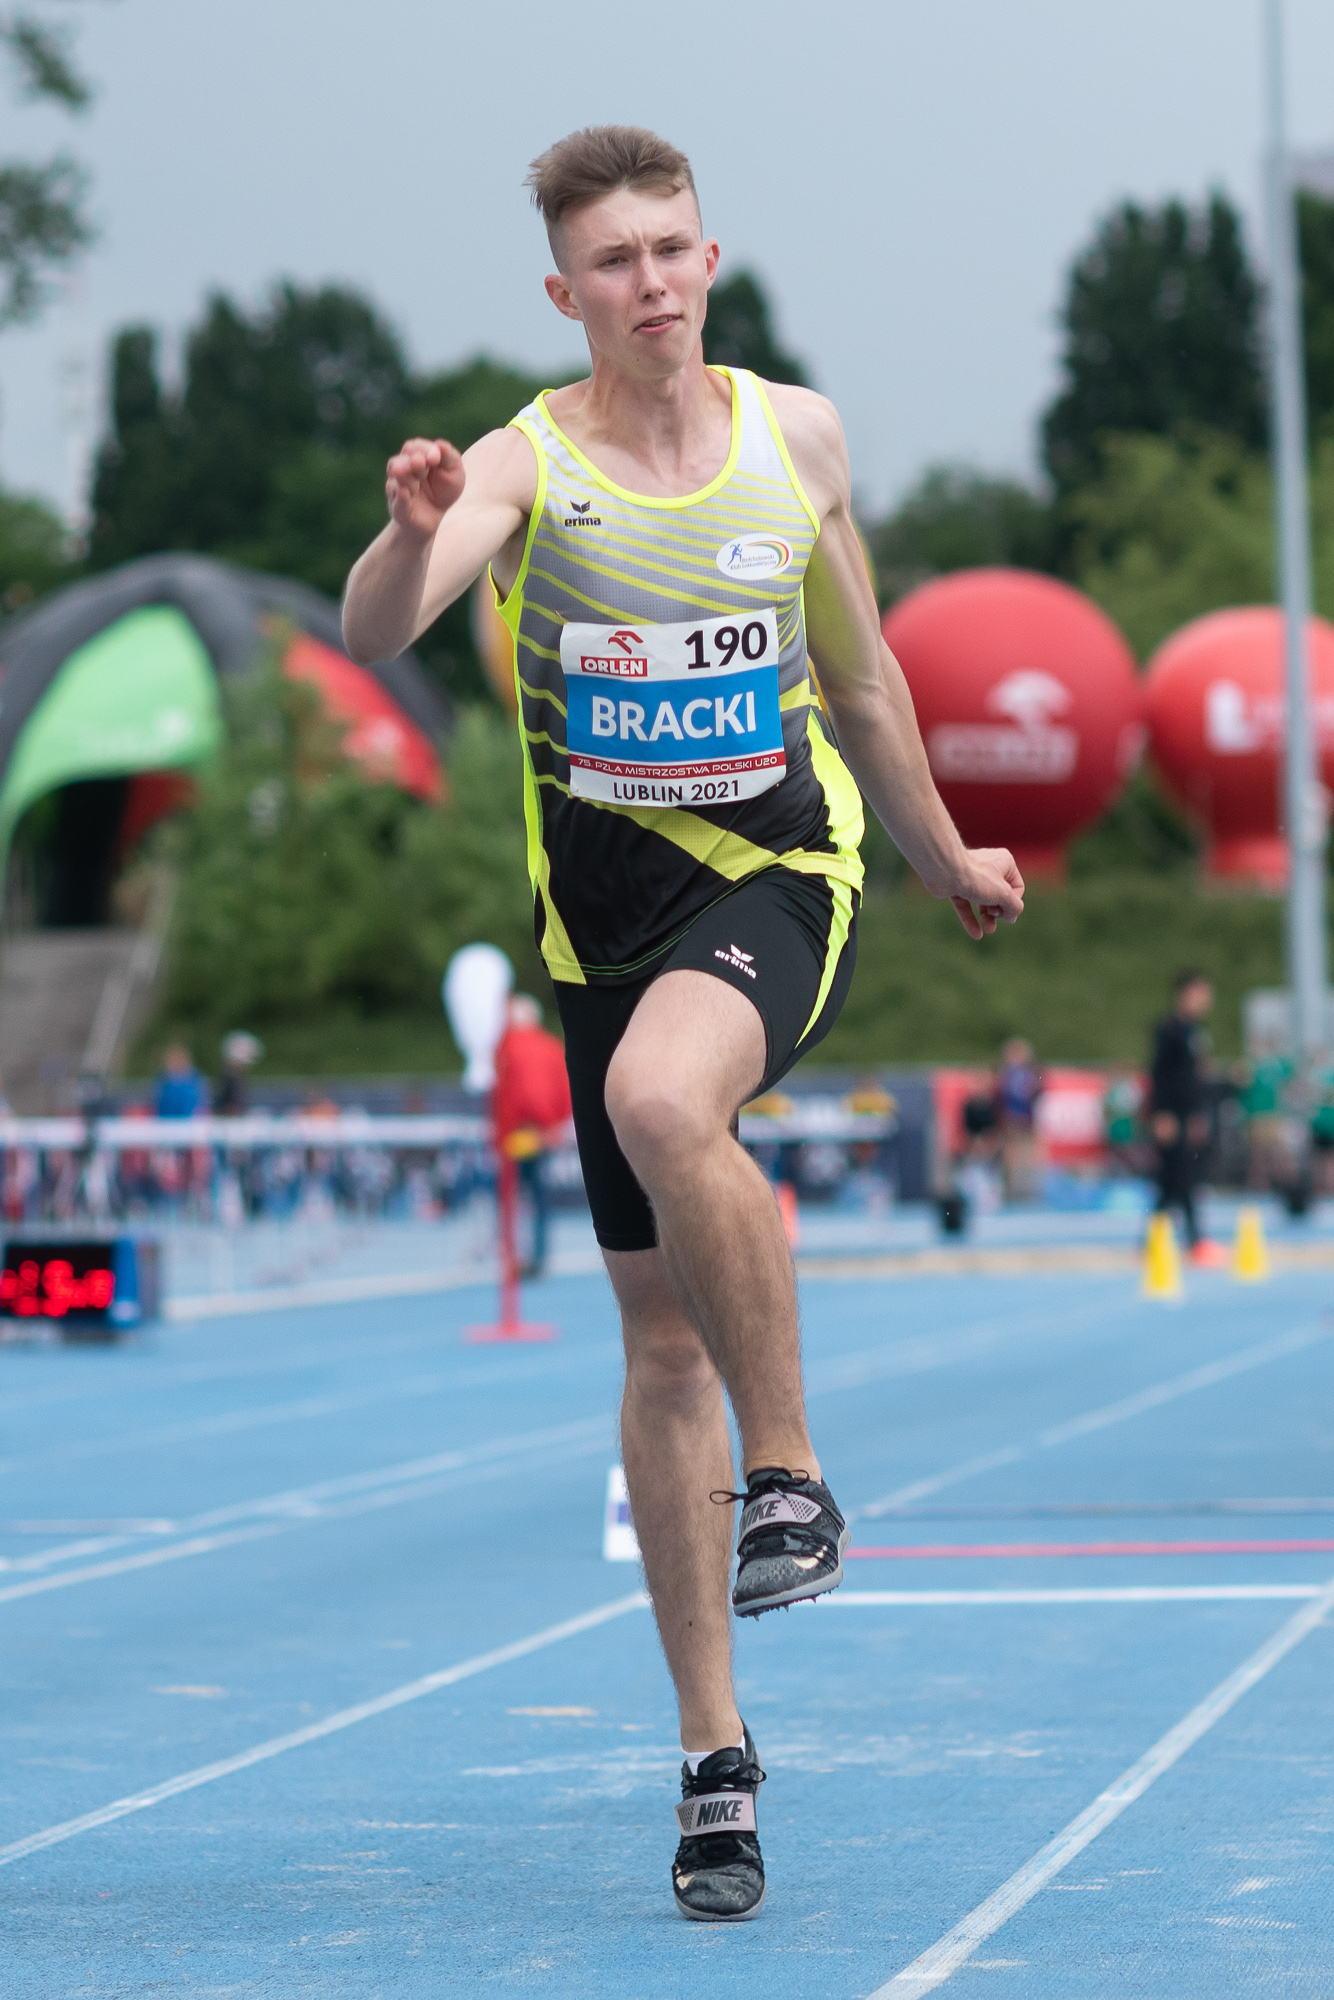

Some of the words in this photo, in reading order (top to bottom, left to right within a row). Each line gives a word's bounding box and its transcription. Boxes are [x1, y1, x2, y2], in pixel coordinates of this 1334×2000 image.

[564, 516, 601, 527] erima
[684, 621, 768, 670] 190
[583, 658, 644, 676] ORLEN
[591, 690, 757, 742] BRACKI
[577, 757, 594, 768] 75.
[595, 761, 623, 774] PZLA
[624, 766, 710, 777] MISTRZOSTWA
[712, 760, 752, 773] POLSKI
[754, 756, 778, 767] U20
[613, 782, 683, 802] LUBLIN
[691, 780, 739, 801] 2021
[714, 949, 757, 980] erima
[696, 1800, 744, 1827] NIKE
